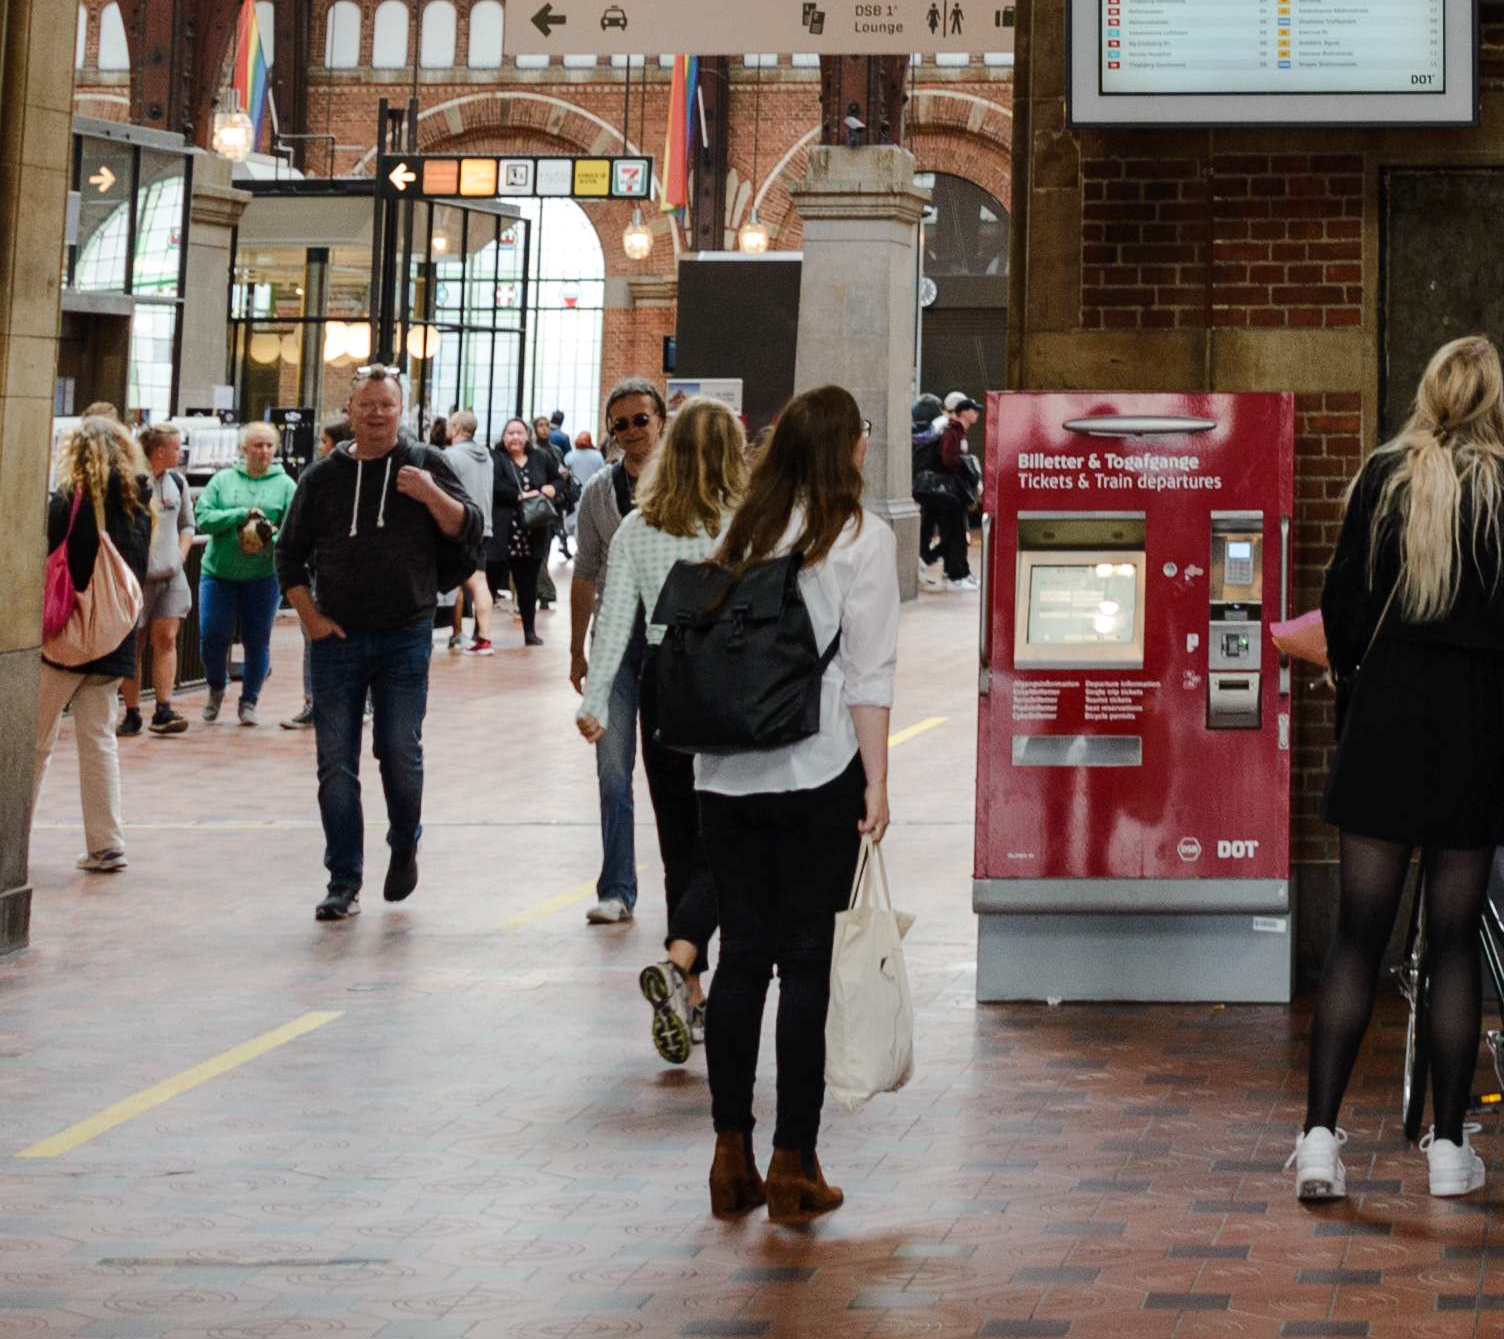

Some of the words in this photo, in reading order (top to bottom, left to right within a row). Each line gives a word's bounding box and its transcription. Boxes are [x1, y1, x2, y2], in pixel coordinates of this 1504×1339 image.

[855, 5, 882, 17] DSB
[854, 22, 904, 35] Lounge
[1410, 75, 1434, 85] DOT
[1018, 453, 1084, 469] Billetter
[1088, 453, 1100, 469] &
[1104, 453, 1199, 472] Togafgange
[1018, 473, 1073, 489] Tickets
[1078, 473, 1090, 489] &
[1095, 473, 1132, 489] Train
[1138, 473, 1222, 492] departures
[1218, 839, 1259, 859] DOT
